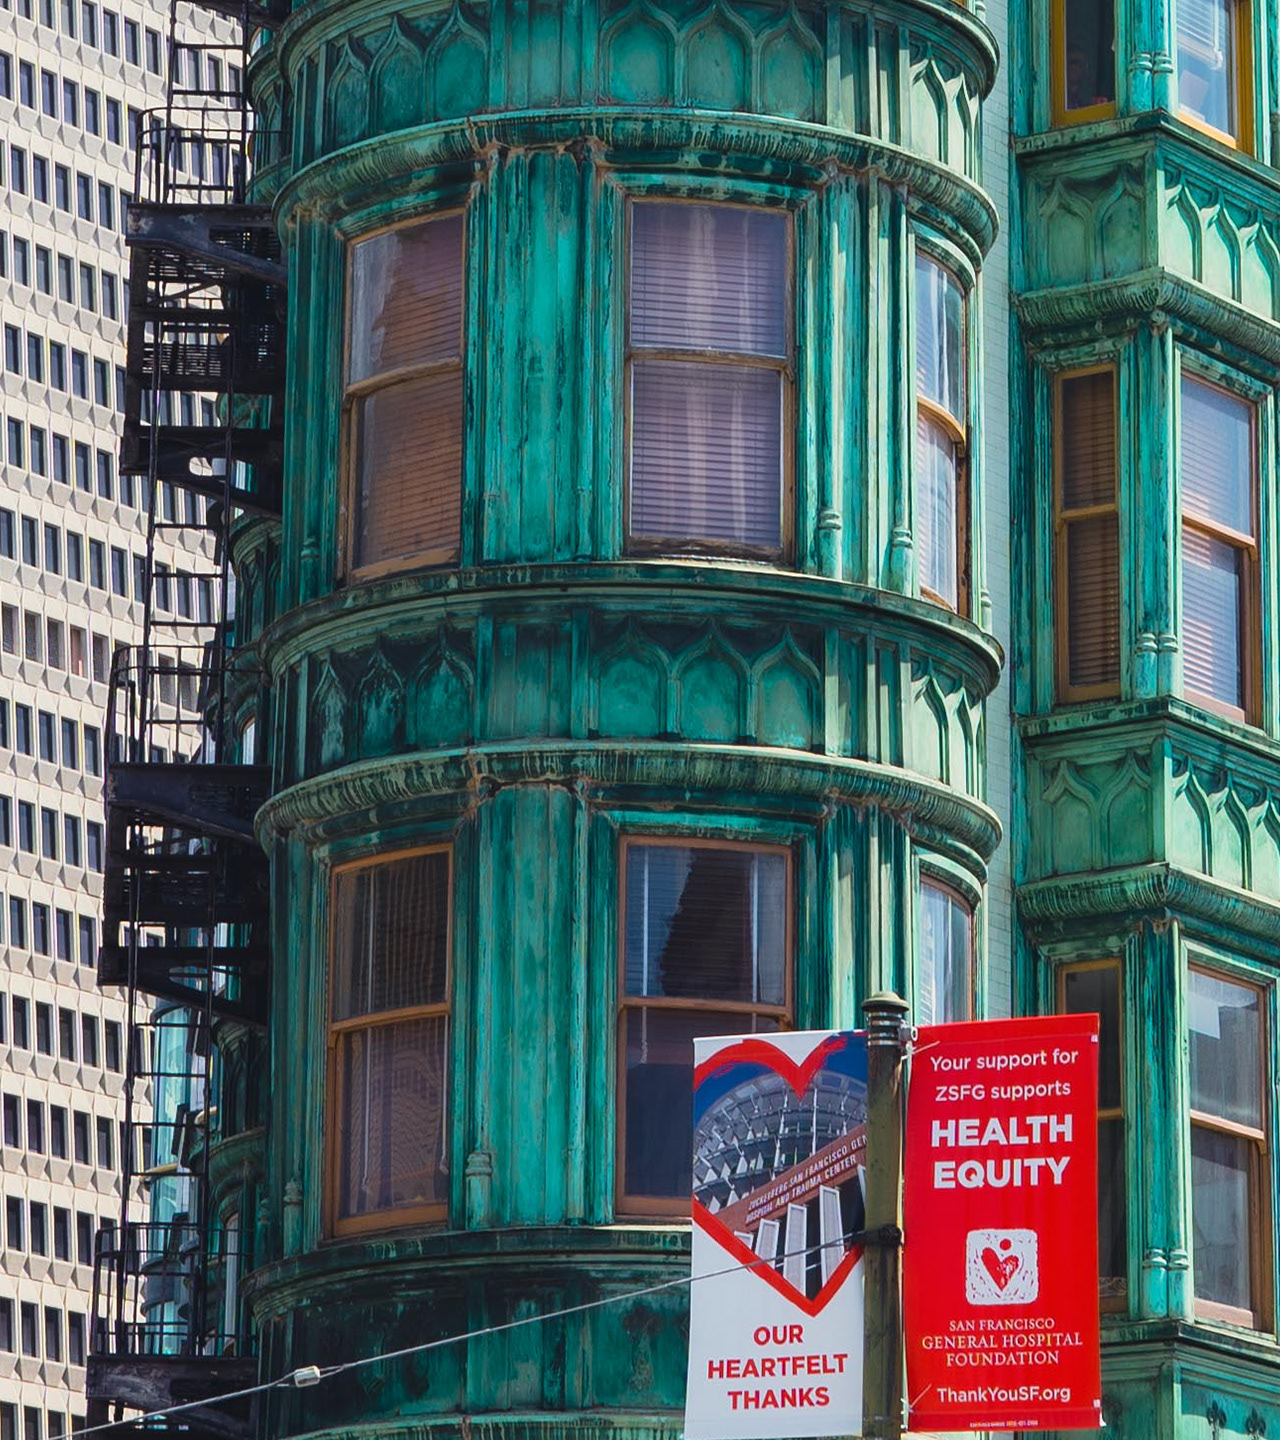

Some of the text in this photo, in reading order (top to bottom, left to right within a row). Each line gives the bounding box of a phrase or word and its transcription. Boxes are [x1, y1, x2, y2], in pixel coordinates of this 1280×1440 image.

[930, 1048, 1079, 1072] Your support for
[935, 1080, 1071, 1101] ZSFG supports
[931, 1114, 1073, 1148] HEALTH
[789, 1174, 803, 1189] SAN
[804, 1147, 848, 1178] FRANCISCO
[933, 1156, 1071, 1189] EQUITY
[776, 1194, 790, 1208] AND
[791, 1175, 821, 1201] TRAUMA
[824, 1153, 858, 1181] CENTER
[753, 1324, 804, 1346] OUR
[949, 1317, 1055, 1332] SAN FRANCISCO
[922, 1331, 1083, 1350] GENERAL HOSPITAL
[707, 1353, 849, 1379] HEARTFELT
[946, 1350, 1059, 1367] FOUNDATION
[727, 1386, 830, 1410] THANKS
[936, 1385, 1071, 1403] ThankYouSF.org
